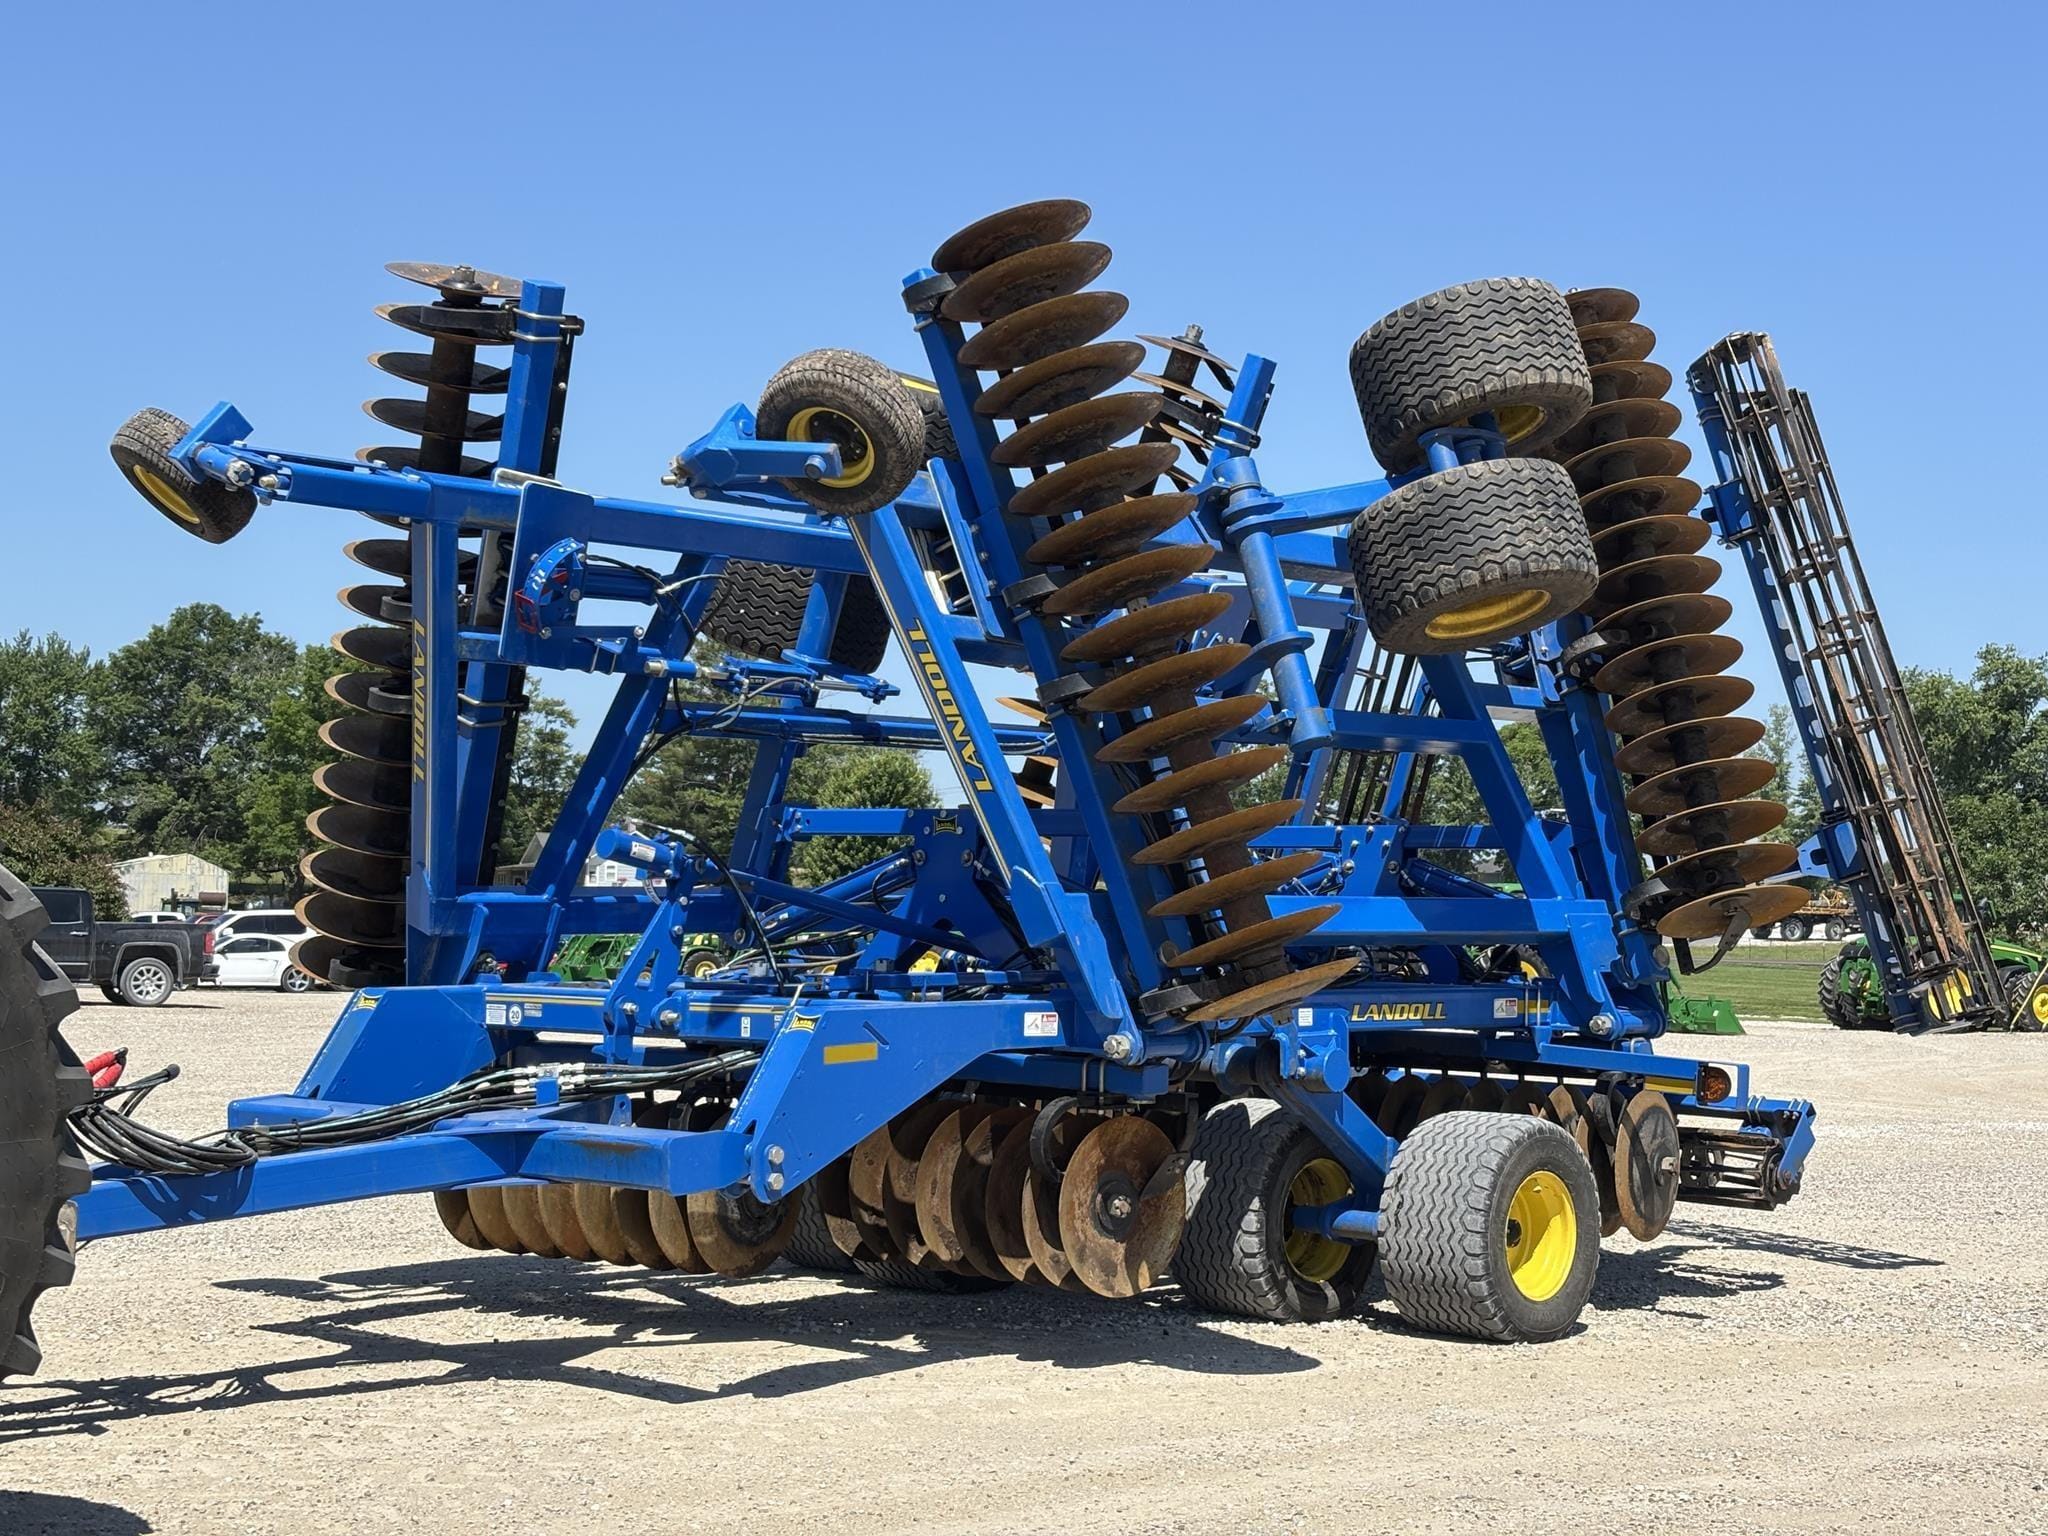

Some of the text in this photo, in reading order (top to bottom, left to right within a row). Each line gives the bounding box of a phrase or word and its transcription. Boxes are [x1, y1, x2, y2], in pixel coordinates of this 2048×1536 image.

[414, 619, 425, 784] LANDOLL
[907, 618, 993, 791] LANDOLL
[511, 1010, 520, 1020] 20
[1350, 1002, 1447, 1022] LANDOLL
